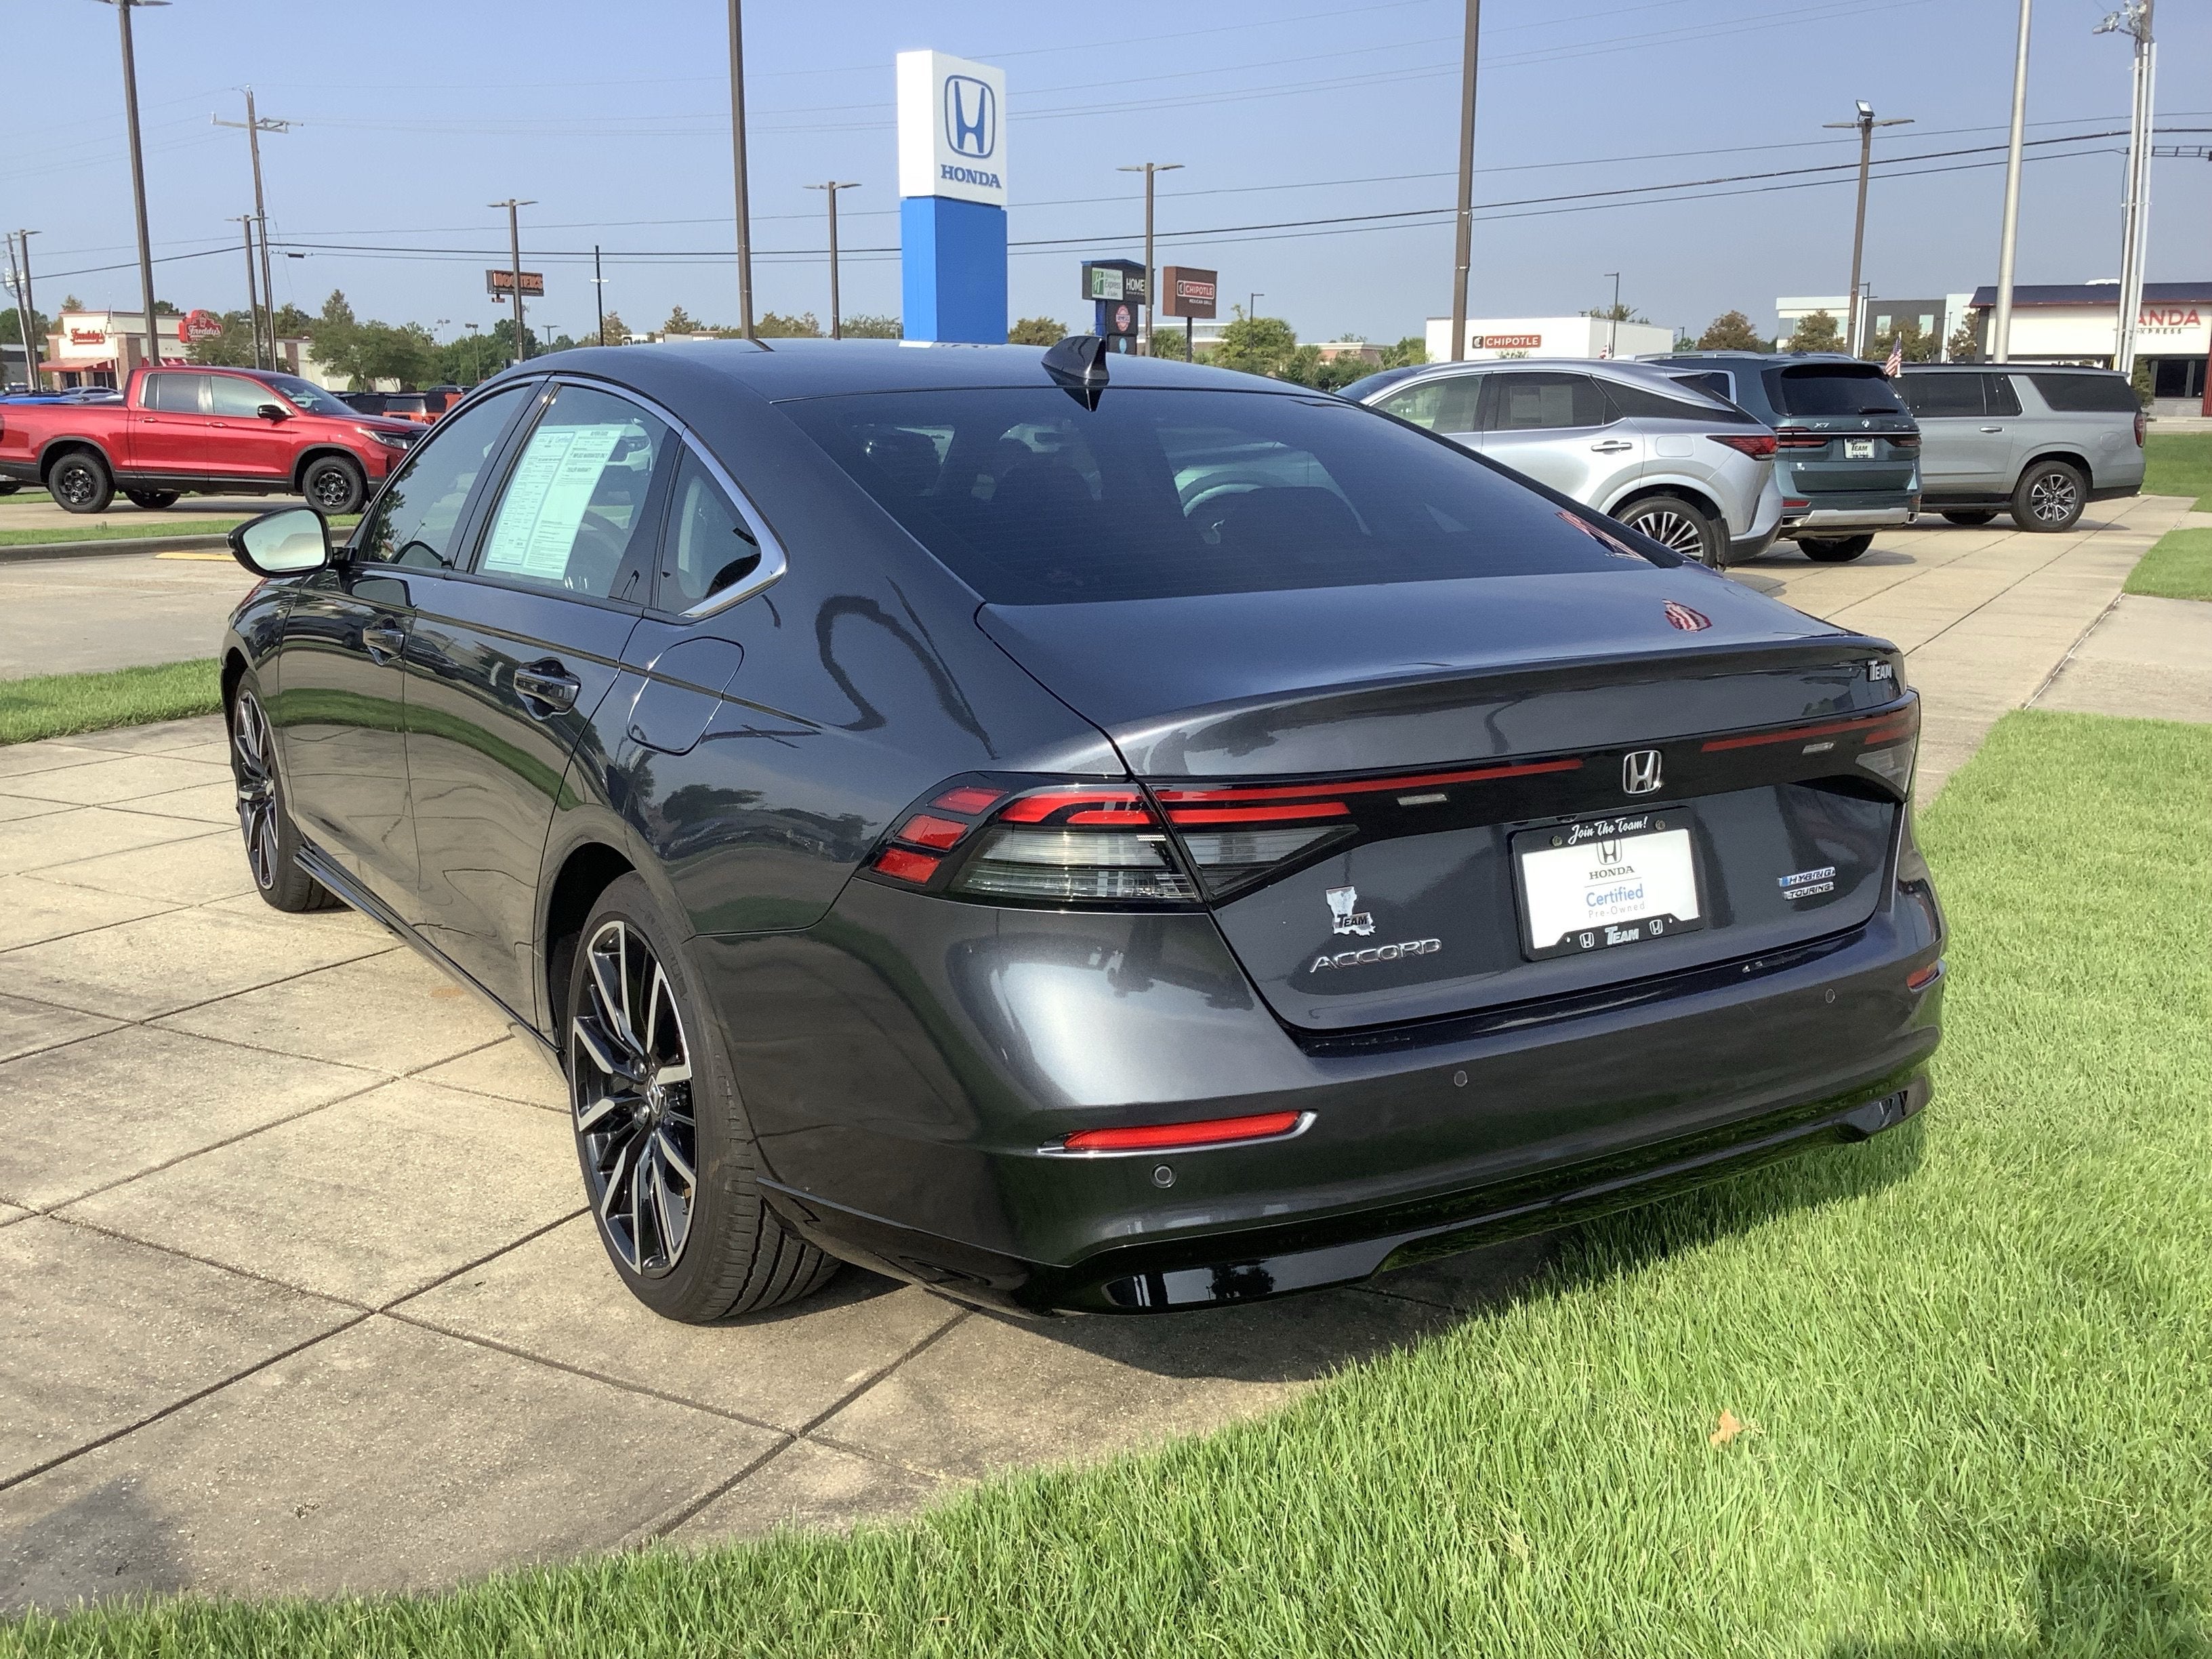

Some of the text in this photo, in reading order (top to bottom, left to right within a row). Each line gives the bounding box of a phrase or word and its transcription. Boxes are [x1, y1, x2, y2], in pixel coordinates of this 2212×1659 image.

[941, 164, 1002, 189] HONDA
[1186, 285, 1213, 295] CHIPOTLE
[2138, 309, 2201, 326] ANDA
[1486, 337, 1538, 346] CHIPOTLE
[1851, 442, 1868, 451] TEAM
[1868, 660, 1892, 681] TEAM
[1568, 816, 1648, 845] Join The Team!
[1589, 865, 1635, 880] HONDA
[1789, 869, 1832, 884] HYBRID
[1586, 884, 1643, 907] Certified
[1790, 884, 1830, 898] TOURING
[1589, 901, 1645, 918] Pre-Owned
[1336, 914, 1368, 928] TEAM
[1605, 926, 1639, 945] TEAM
[1309, 938, 1442, 973] ACCORD
